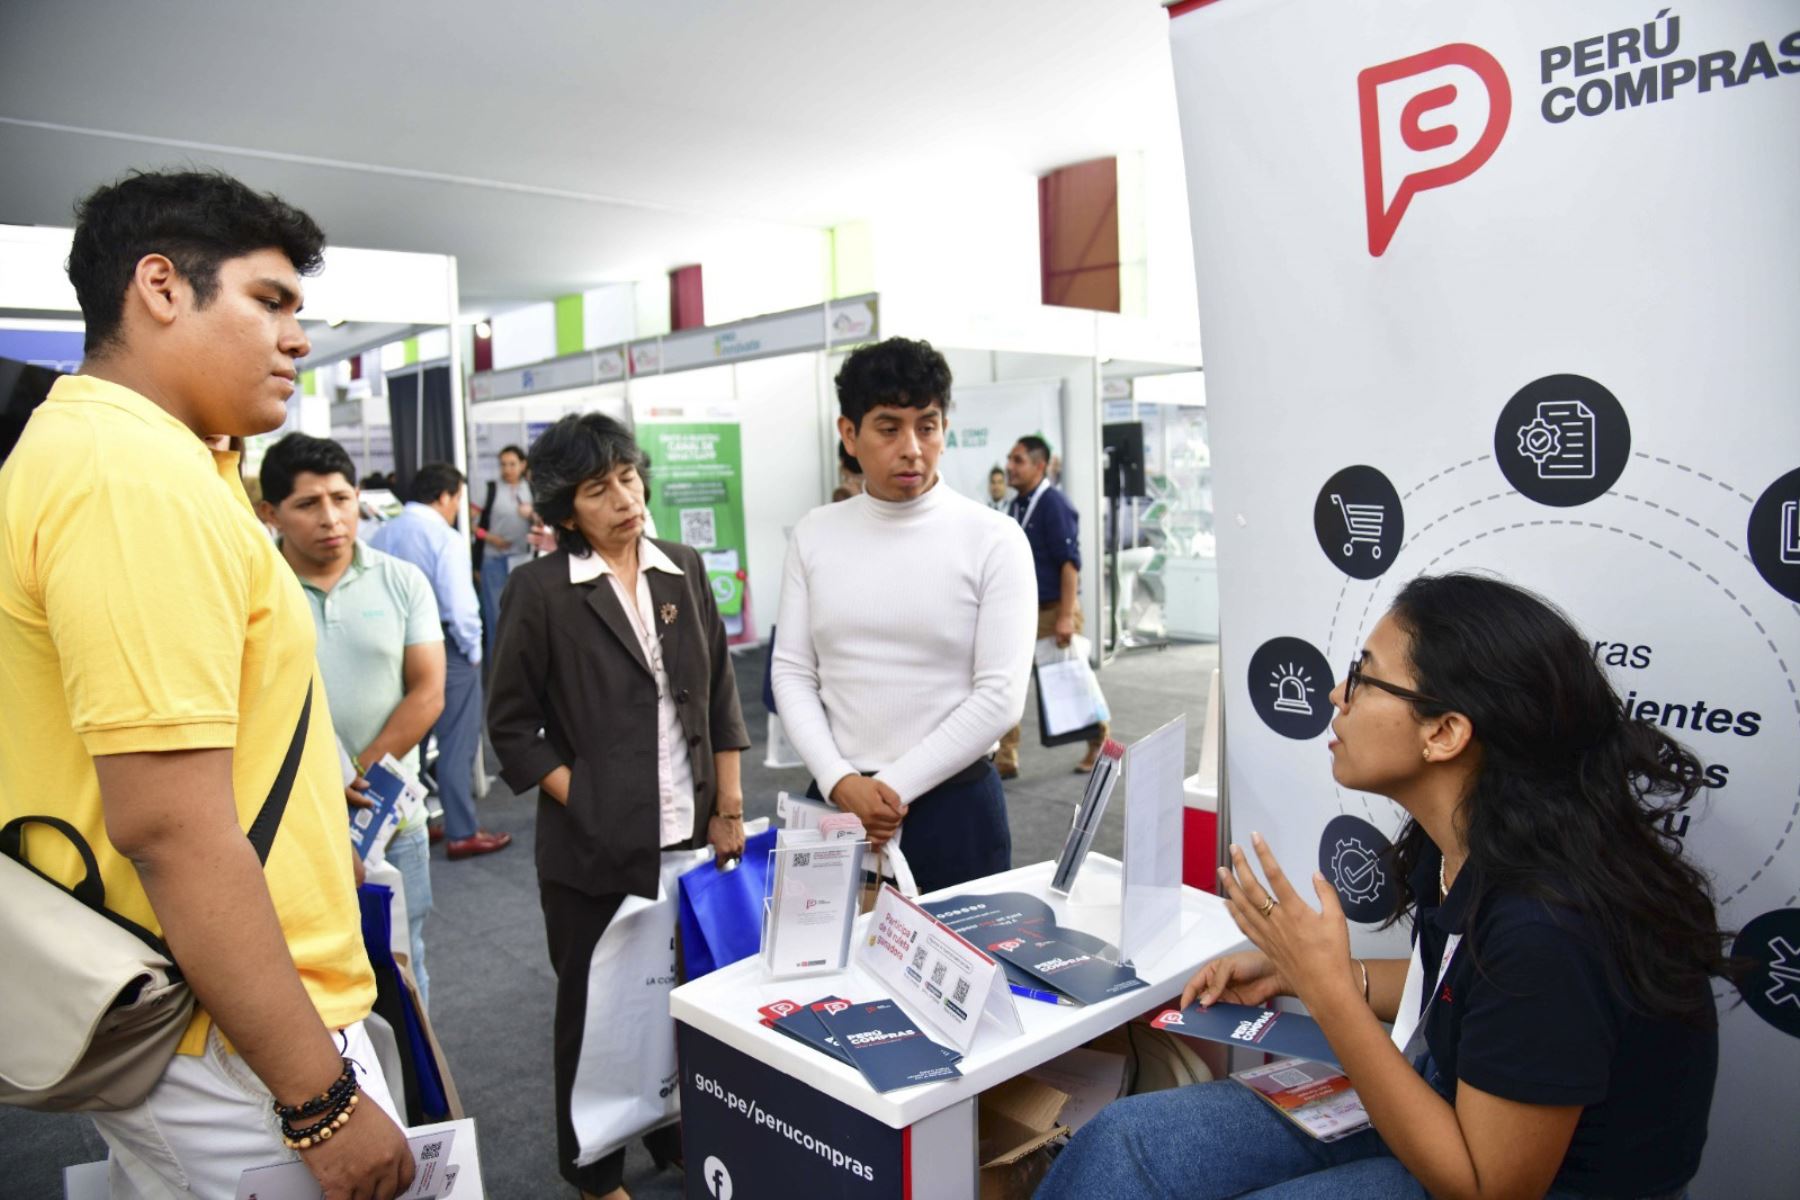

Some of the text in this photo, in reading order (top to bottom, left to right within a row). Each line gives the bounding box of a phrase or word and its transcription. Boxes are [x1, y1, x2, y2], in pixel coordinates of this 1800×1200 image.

[1541, 8, 1681, 84] PERÚ
[1541, 31, 1800, 124] COMPRAS
[1593, 640, 1653, 669] ras
[1624, 691, 1762, 736] ientes
[851, 1029, 916, 1045] COMPRAS
[695, 1072, 875, 1182] gob.pe/perucompras
